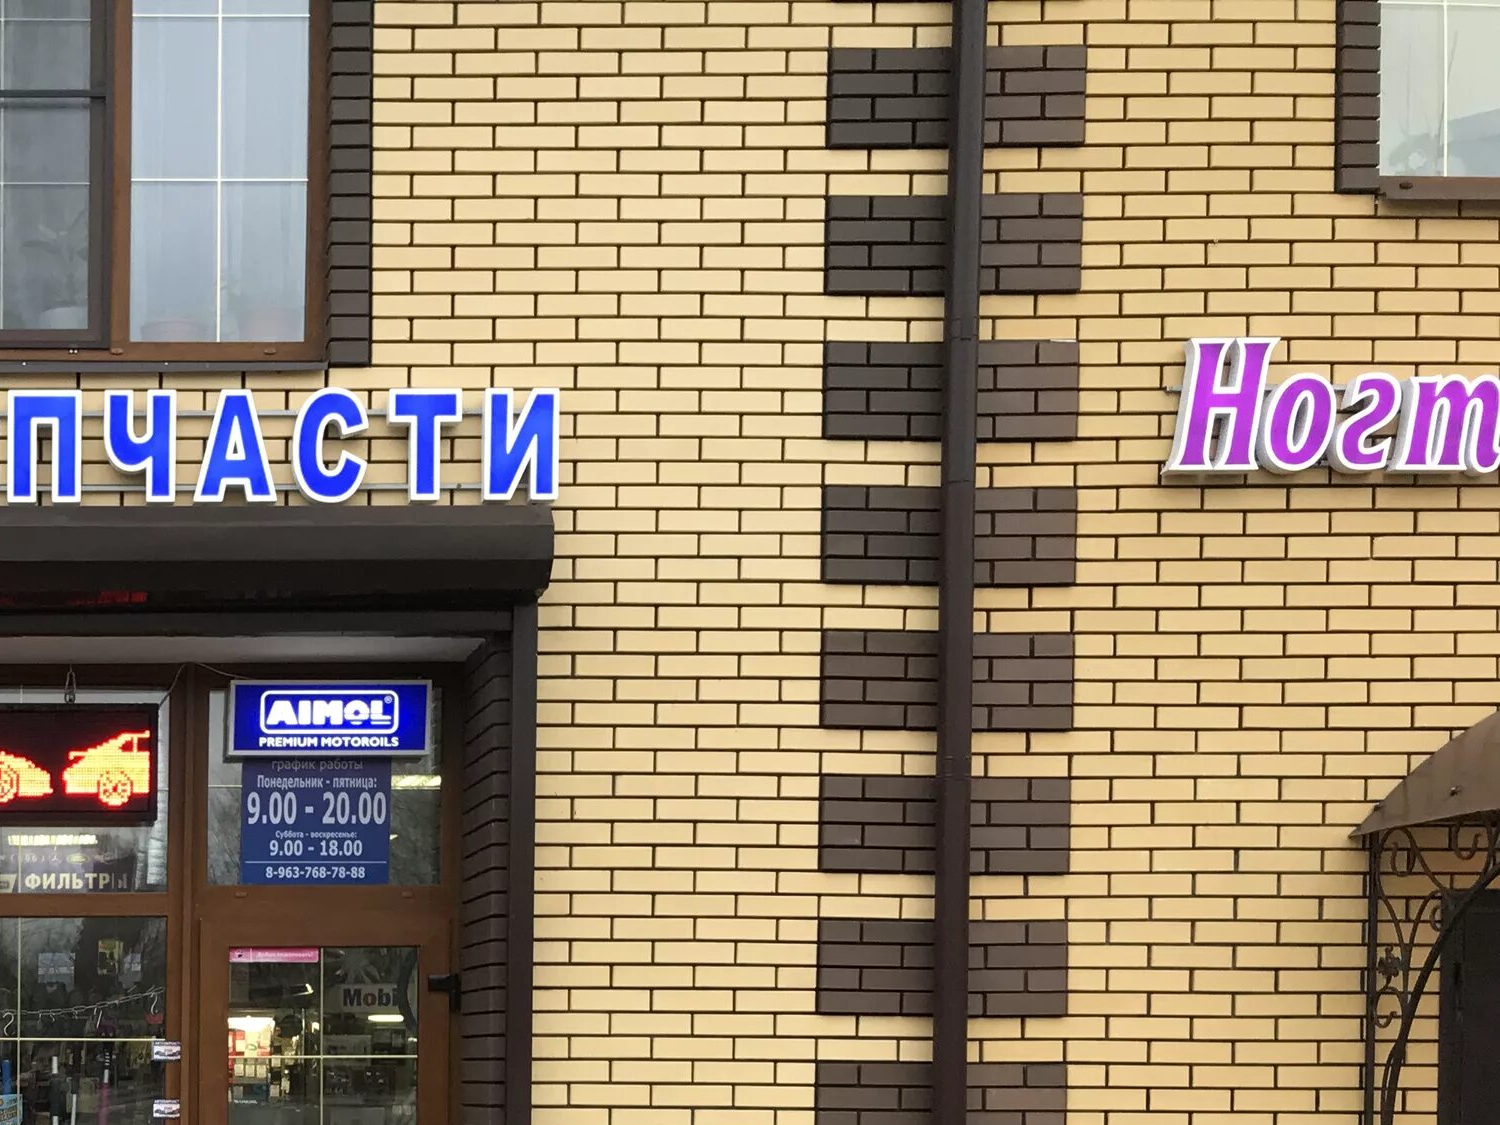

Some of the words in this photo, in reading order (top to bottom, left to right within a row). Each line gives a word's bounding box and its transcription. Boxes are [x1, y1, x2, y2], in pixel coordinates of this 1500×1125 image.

[266, 698, 392, 726] AIMOL
[258, 736, 319, 748] PREMIUM
[321, 736, 399, 748] MOTOROILS
[271, 758, 316, 772] график
[319, 758, 364, 771] работы
[257, 775, 324, 790] Понедельник
[332, 777, 378, 790] пятница:
[247, 791, 298, 826] 9.00
[322, 791, 387, 826] 20.00
[275, 830, 304, 840] Суббота
[311, 831, 357, 839] воскресенье:
[269, 839, 303, 857] 9.00
[319, 839, 363, 857] 18.00
[265, 866, 366, 880] 8-963-768-78-88
